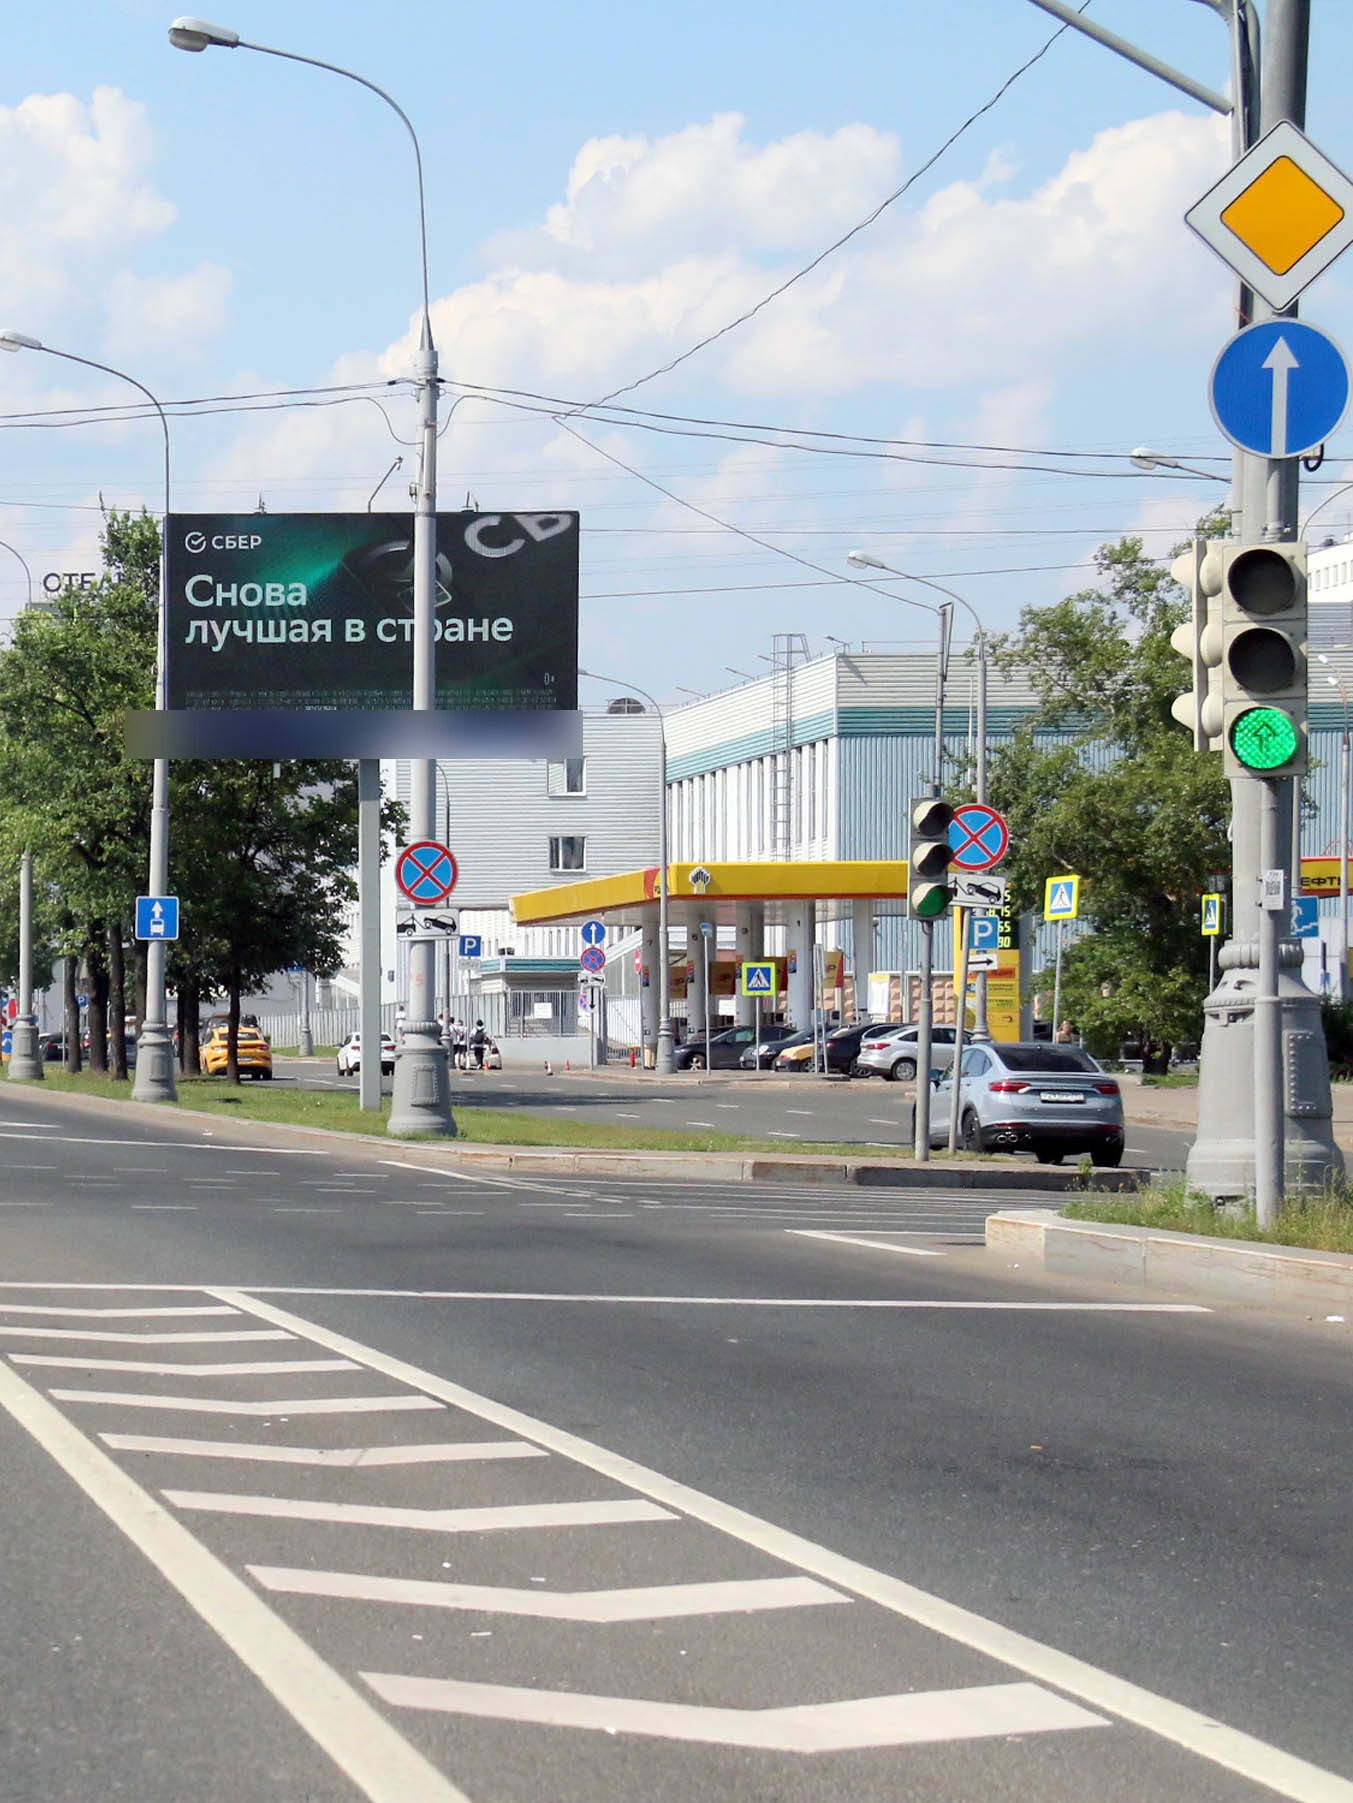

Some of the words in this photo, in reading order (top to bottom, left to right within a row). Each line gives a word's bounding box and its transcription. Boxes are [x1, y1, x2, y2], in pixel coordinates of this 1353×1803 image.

[211, 534, 263, 550] СБЕР
[185, 574, 308, 607] Снова
[184, 618, 333, 653] лучшая
[345, 619, 366, 642] в
[464, 938, 477, 955] P
[973, 920, 993, 947] P
